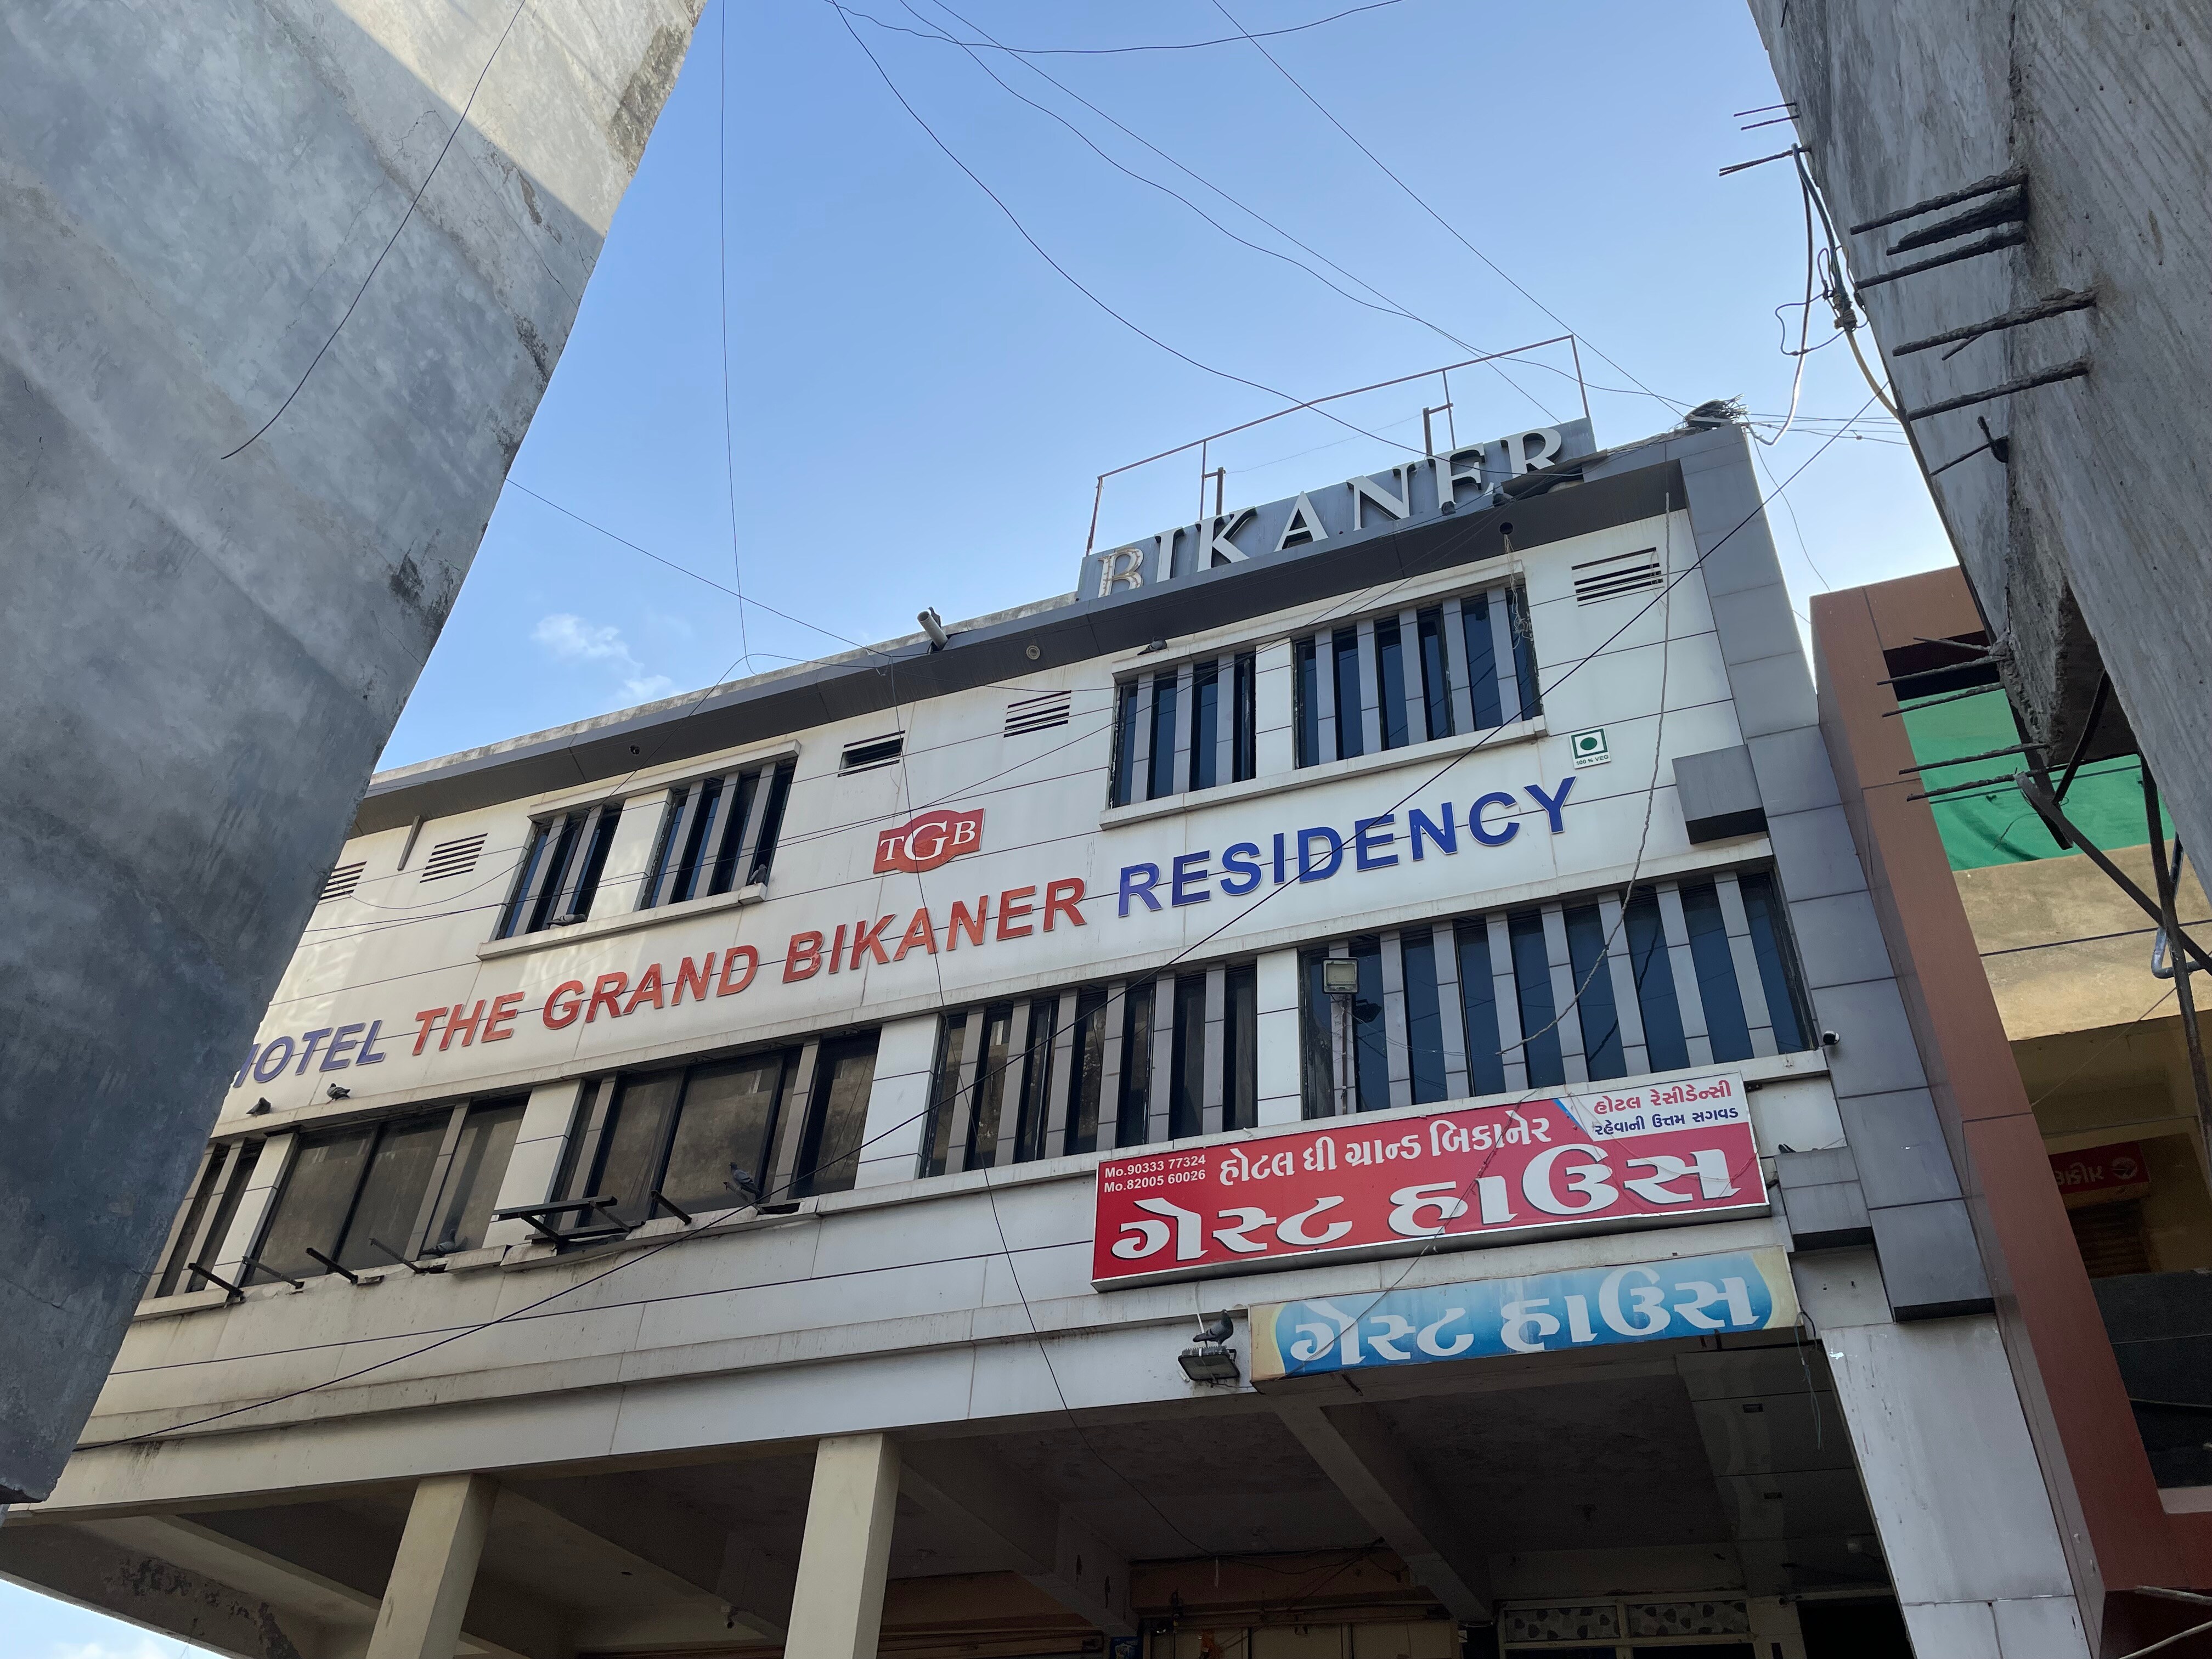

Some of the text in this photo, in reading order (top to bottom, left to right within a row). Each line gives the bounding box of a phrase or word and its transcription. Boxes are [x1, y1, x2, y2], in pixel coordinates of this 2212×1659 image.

[1097, 427, 1563, 599] BIKANER
[879, 820, 977, 862] TGB
[411, 991, 525, 1057] THE
[542, 945, 759, 1030] GRAND
[782, 877, 1087, 984] BIKANER
[1118, 776, 1577, 918] RESIDENCY
[1594, 1080, 1732, 1114] હોટલ રેસીડેન્સી
[1595, 1107, 1739, 1135] રહેવાની ઉત્તમ સગવડ
[1105, 1154, 1206, 1178] Mo.90333 77324
[1220, 1148, 1295, 1186] હોટલ
[1346, 1134, 1421, 1166] ગ્રાન્ડ
[1430, 1116, 1552, 1156] બિકાનેર
[1104, 1170, 1205, 1193] Mo.82005 60026
[1111, 1143, 1742, 1261] ગેસ્ટ હાઉસ
[1290, 1265, 1760, 1364] ગેસ્ટ હાઉસ
